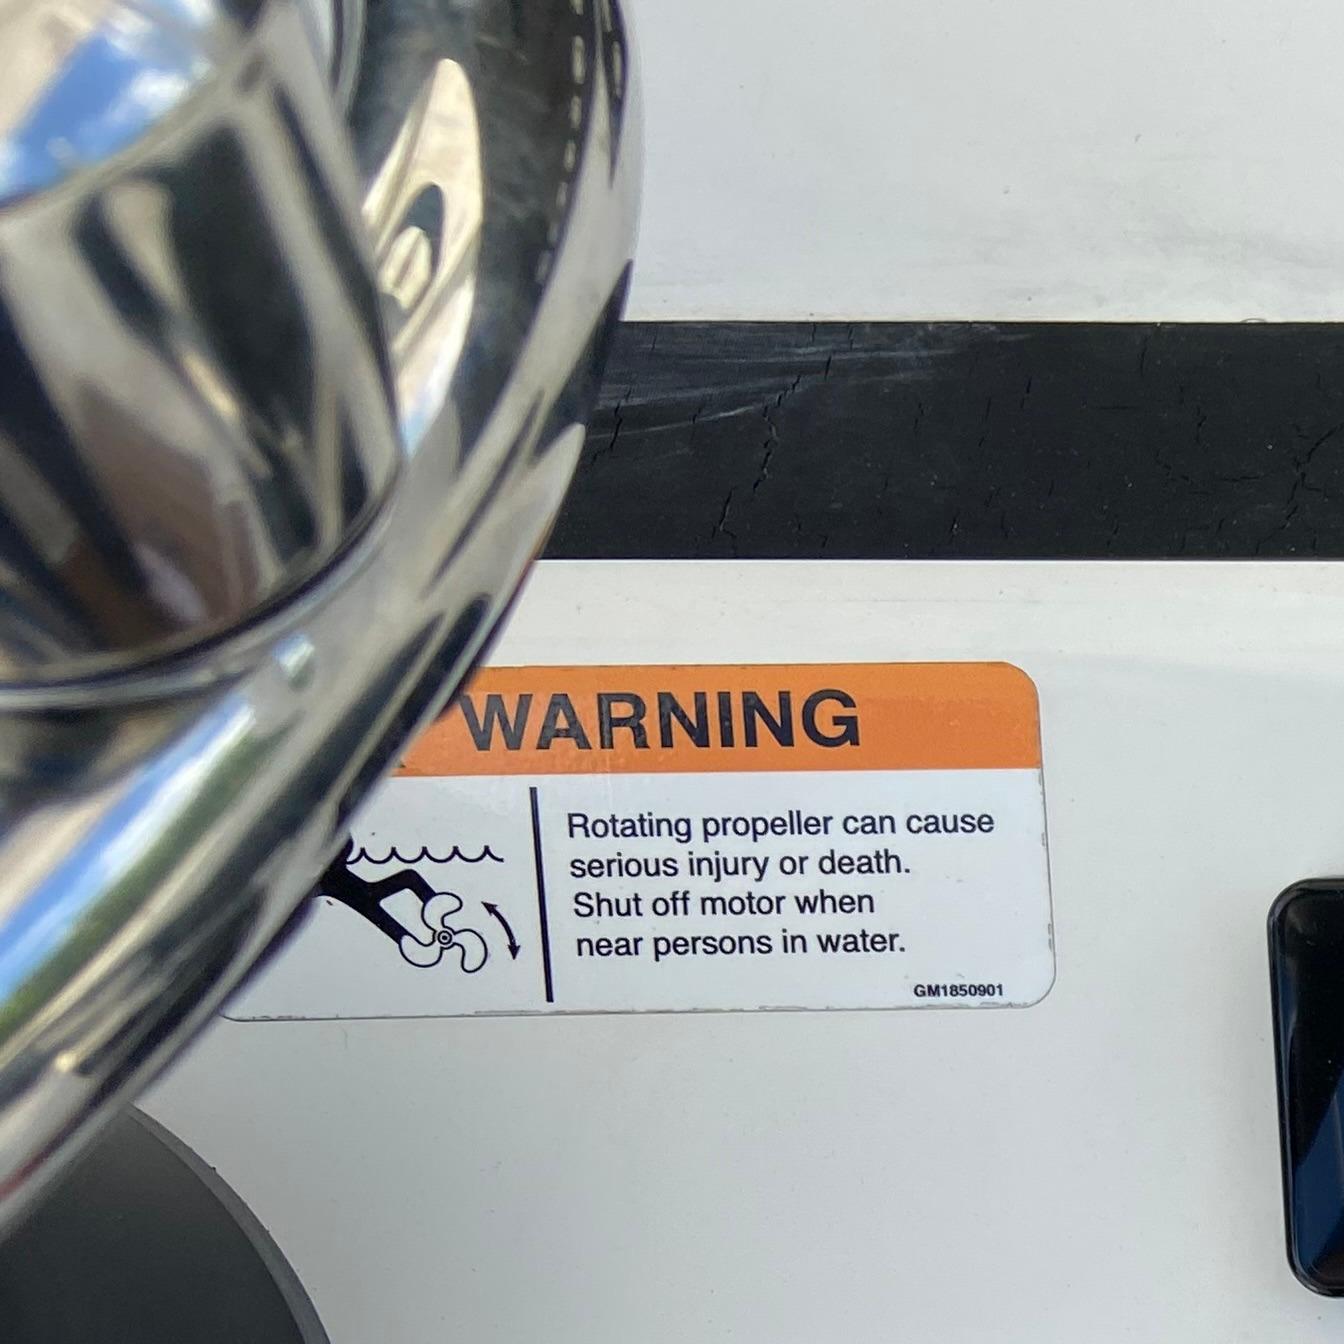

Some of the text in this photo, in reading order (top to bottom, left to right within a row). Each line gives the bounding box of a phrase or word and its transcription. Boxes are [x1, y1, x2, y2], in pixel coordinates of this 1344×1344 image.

[459, 688, 861, 751] WARNING
[567, 810, 994, 844] Rotating propeller can cause
[570, 848, 911, 882] serious injury or death.
[573, 889, 875, 918] Shut off motor when
[577, 928, 906, 962] near persons in water.
[913, 983, 1004, 998] GM1850901
